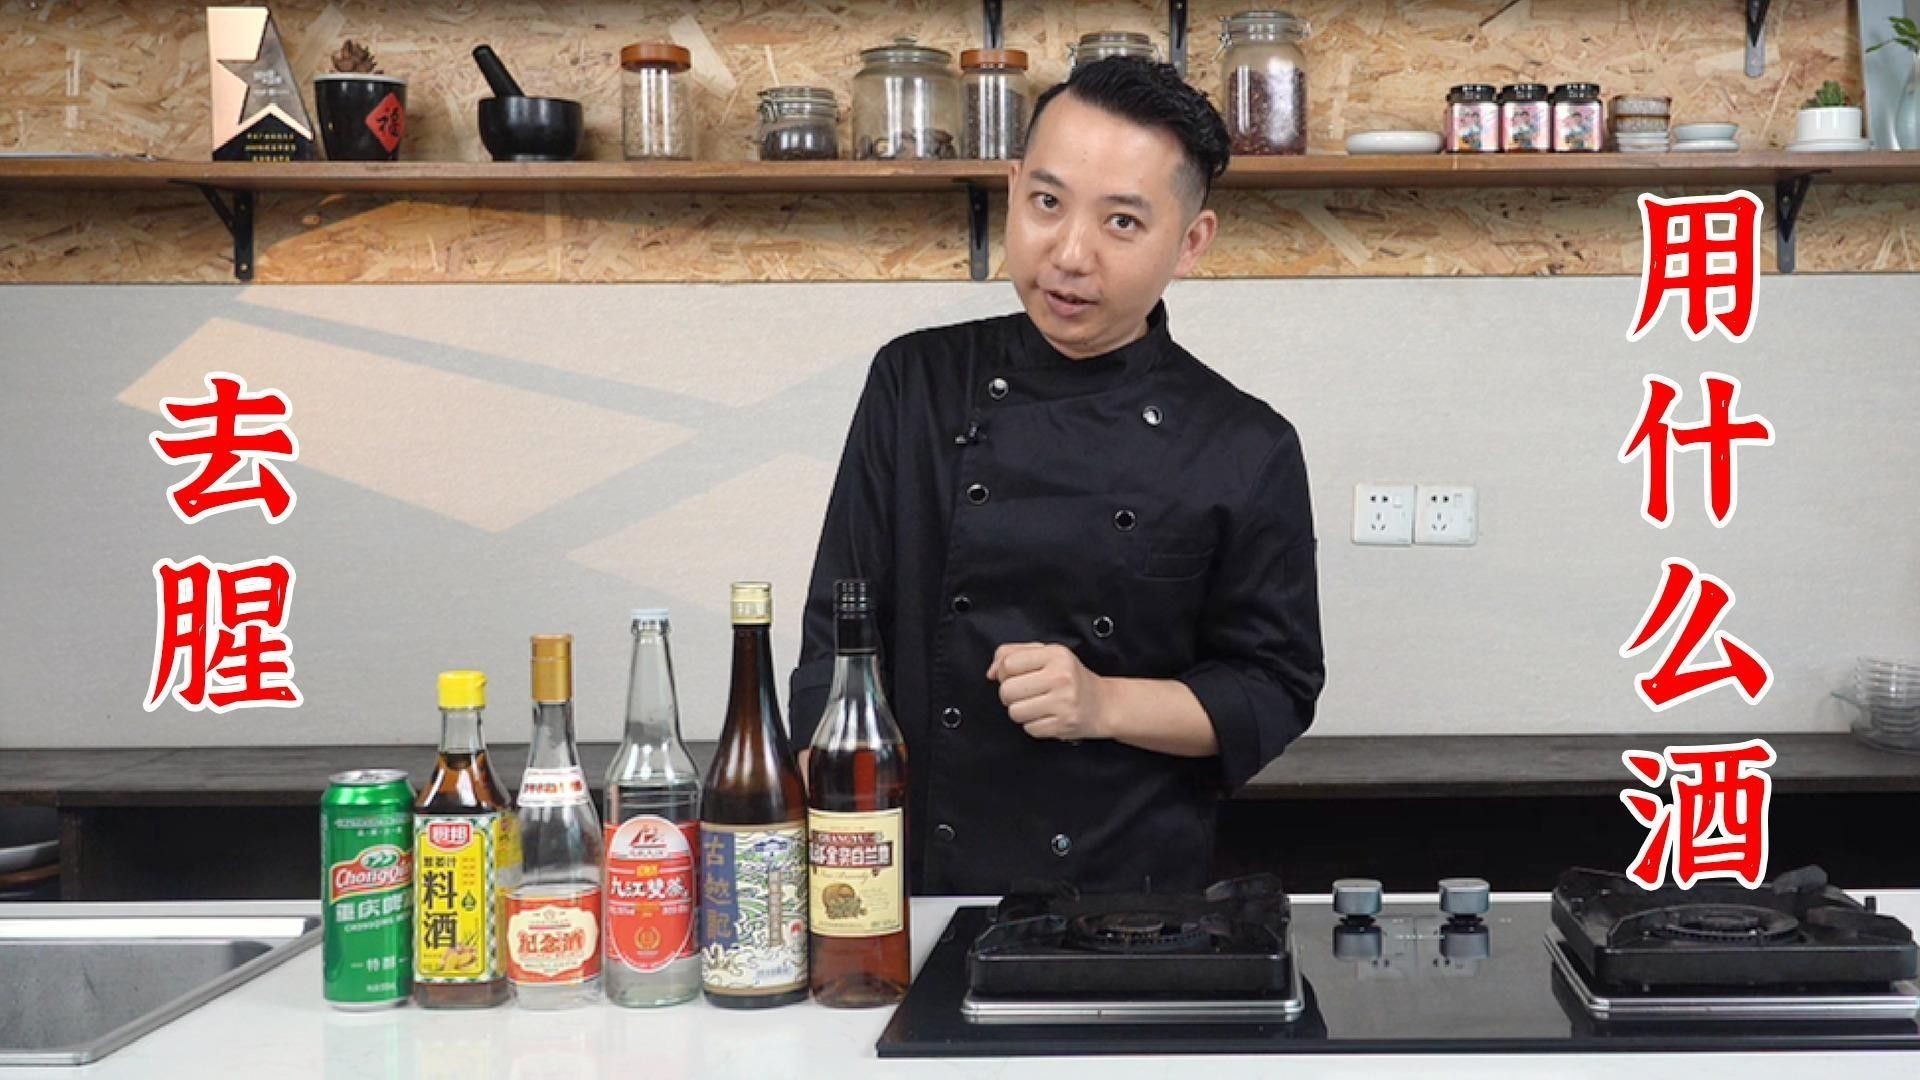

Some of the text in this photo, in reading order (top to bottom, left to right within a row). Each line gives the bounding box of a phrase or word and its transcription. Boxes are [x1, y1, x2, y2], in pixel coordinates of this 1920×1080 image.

[336, 892, 412, 922] 重庆啤
[423, 870, 457, 950] 料酒
